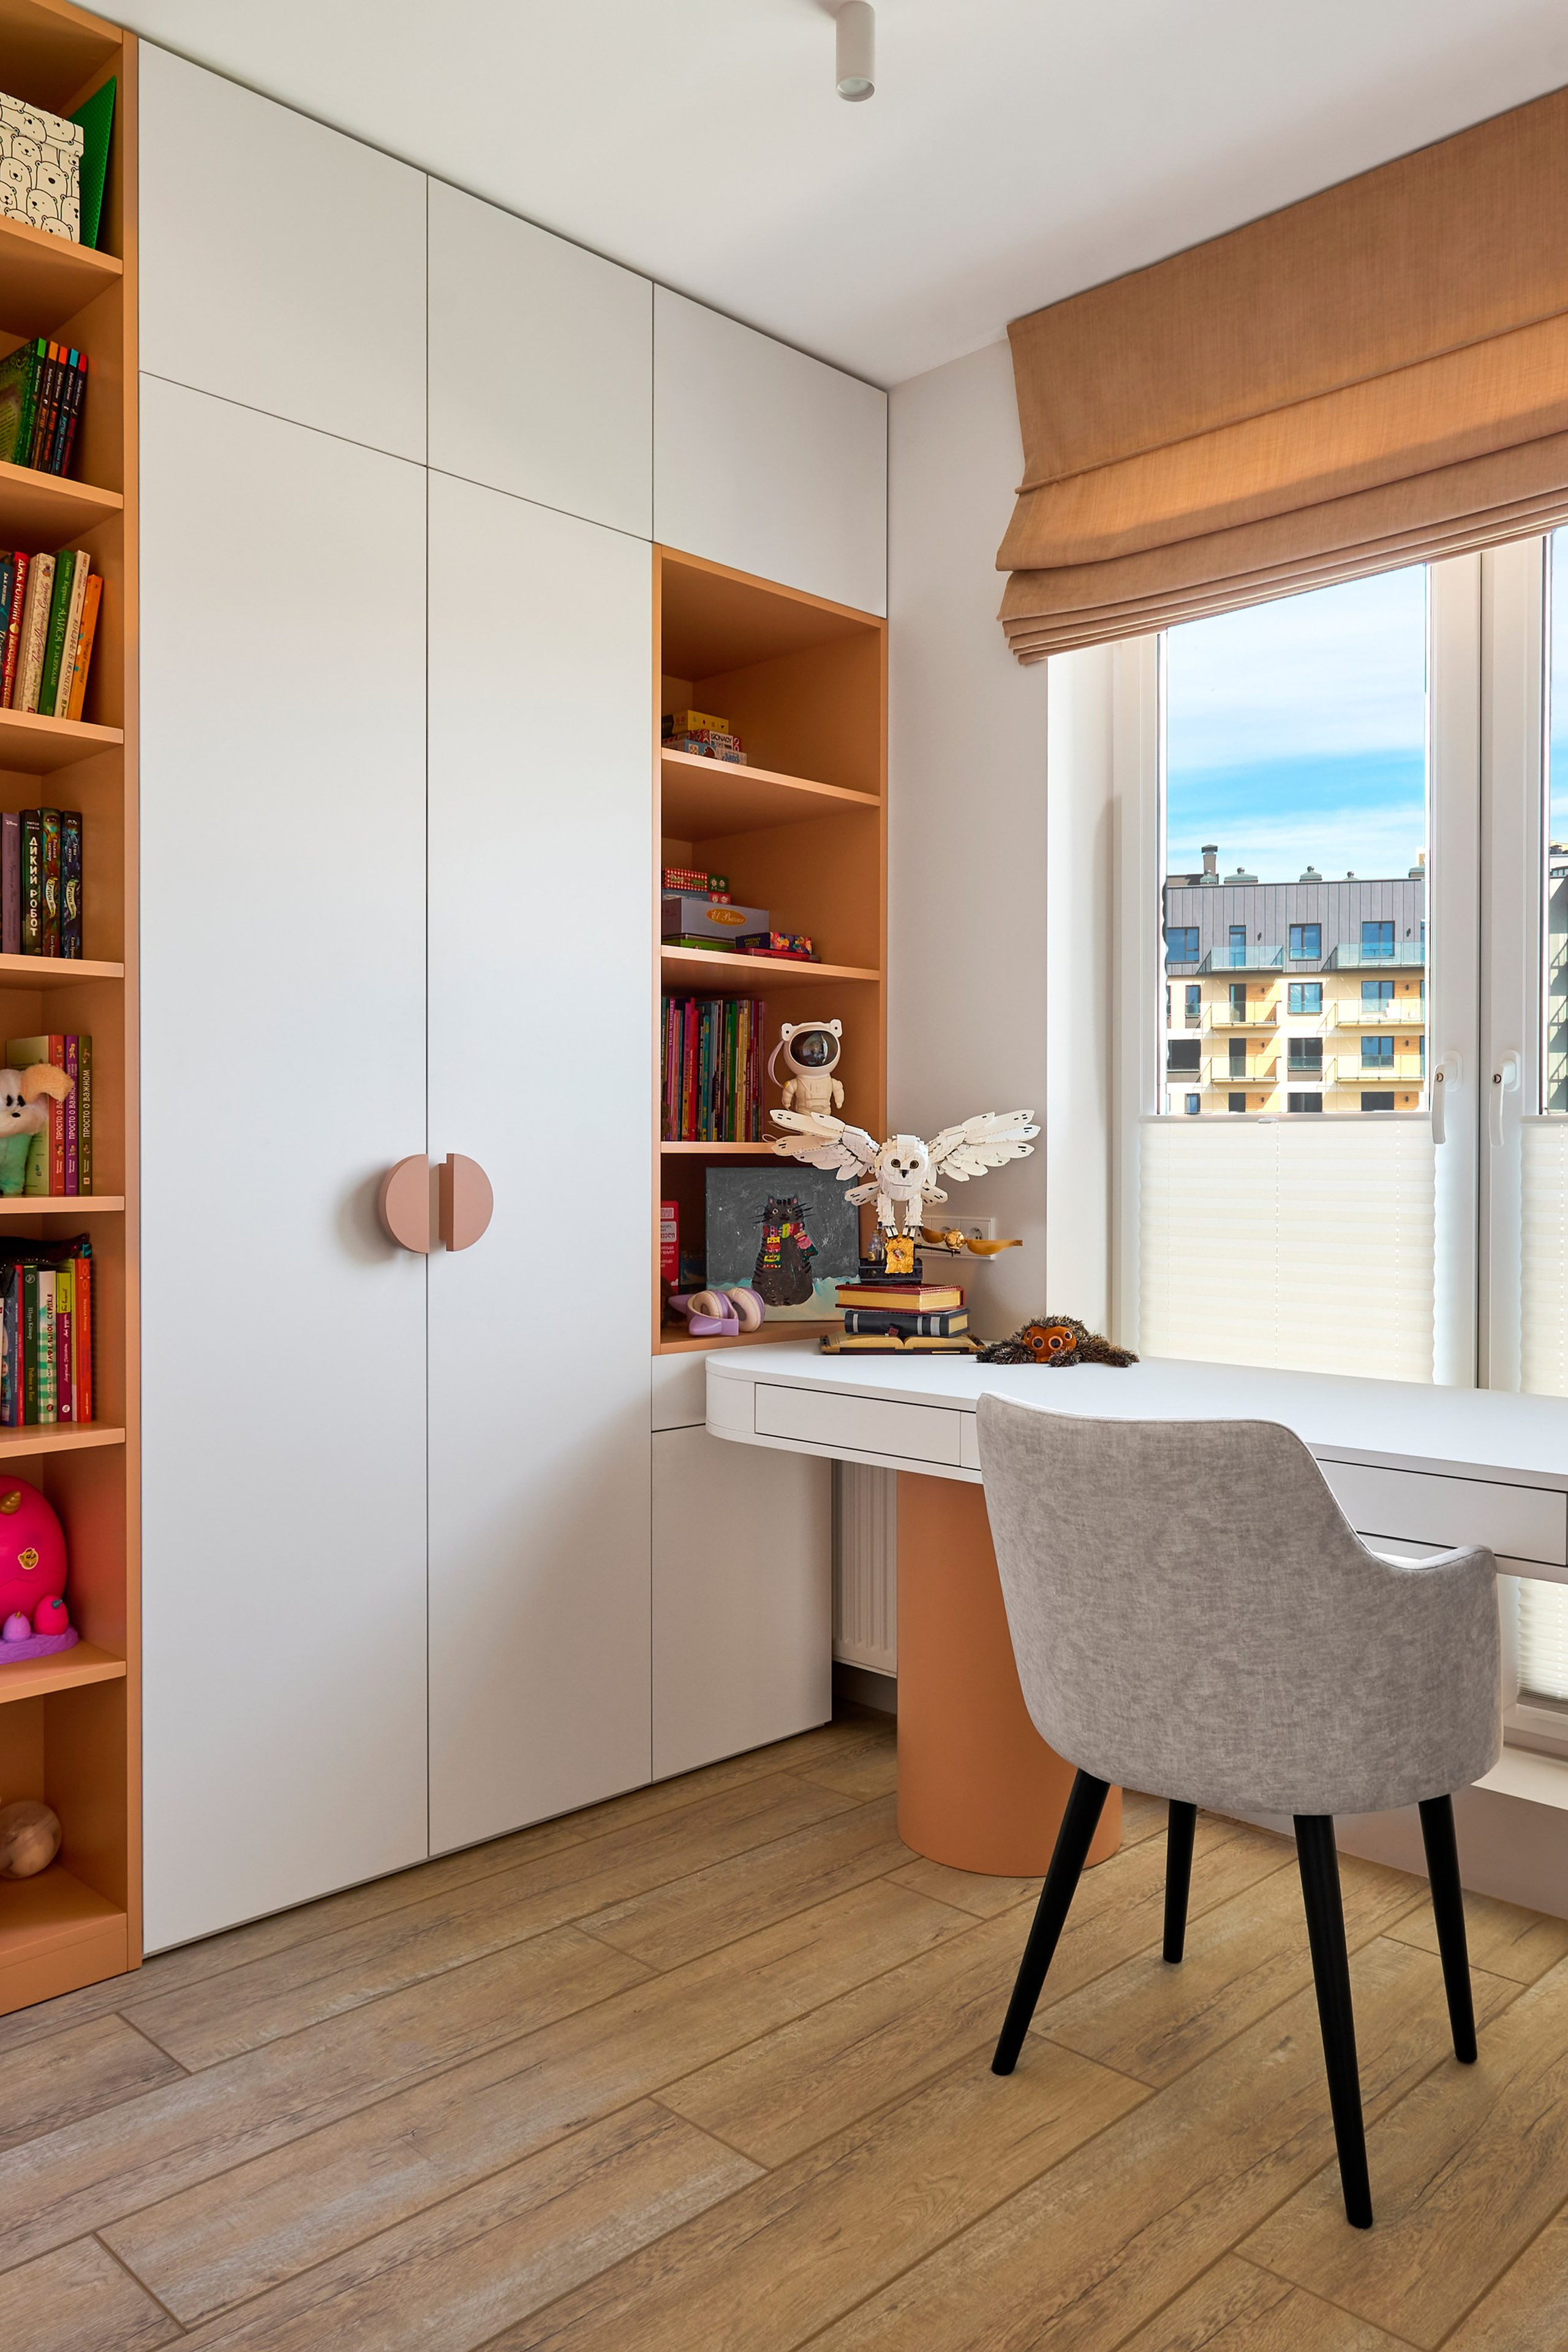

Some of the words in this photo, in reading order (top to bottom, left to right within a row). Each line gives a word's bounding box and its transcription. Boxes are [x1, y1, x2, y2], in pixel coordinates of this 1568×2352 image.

[10, 583, 24, 622] РОУЛИНГ
[54, 607, 67, 643] АЛИСА
[61, 661, 73, 696] ИСКУССТВЕ
